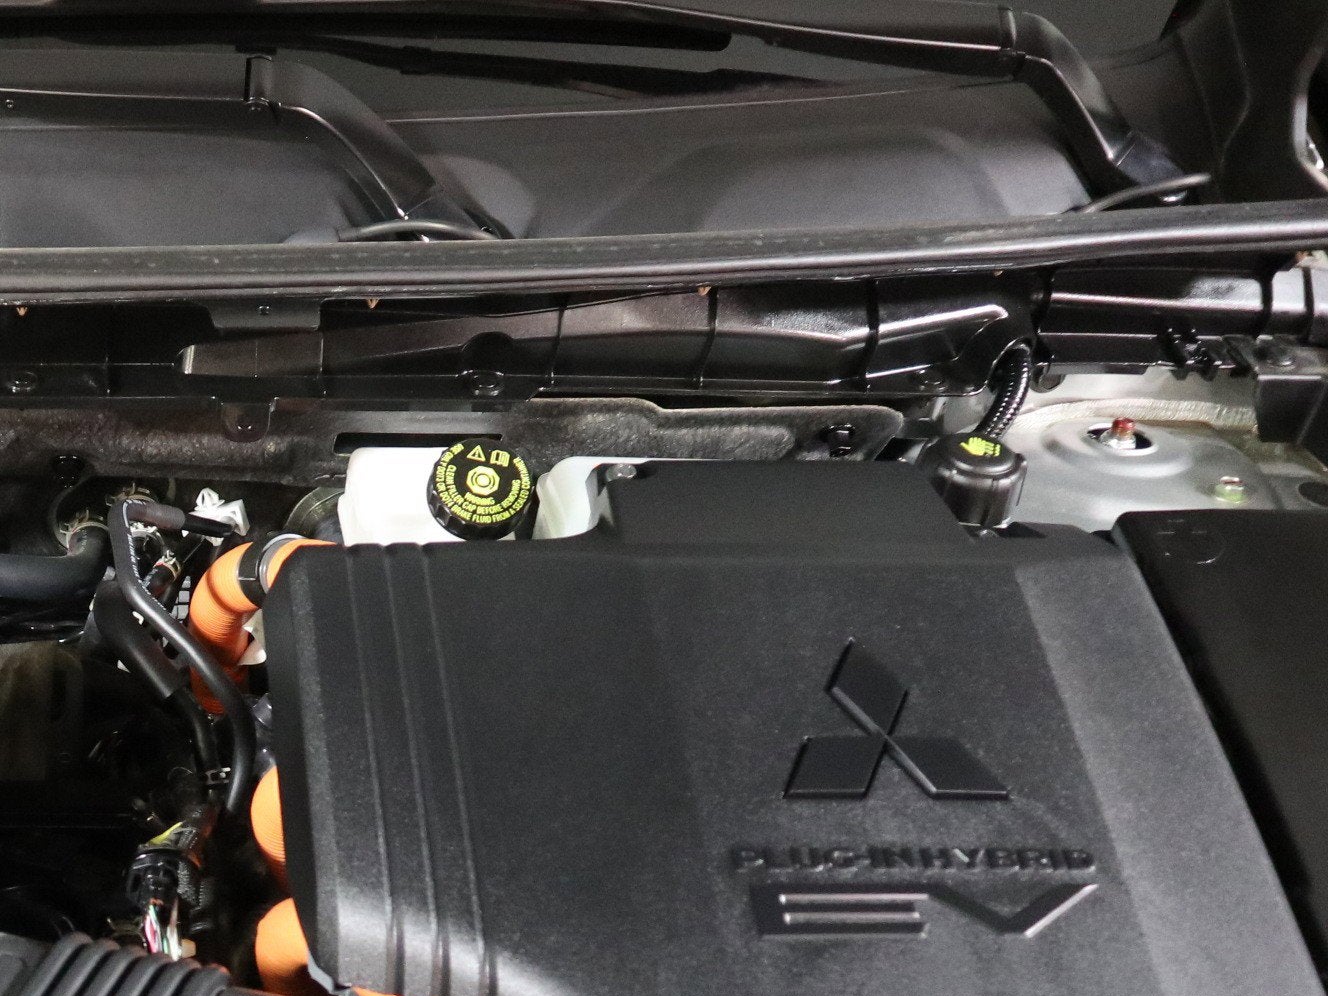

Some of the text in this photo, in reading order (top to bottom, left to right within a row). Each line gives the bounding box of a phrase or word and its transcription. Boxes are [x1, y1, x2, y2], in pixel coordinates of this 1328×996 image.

[513, 456, 531, 490] CONTAINER
[436, 482, 446, 492] OR
[445, 464, 521, 515] CLEAN FILLER CAP BEFORE REMOVING
[439, 491, 454, 507] DOT4
[513, 489, 529, 512] SEALED
[451, 504, 473, 520] BRAKE
[472, 514, 492, 524] FLUID
[492, 510, 511, 522] FROM
